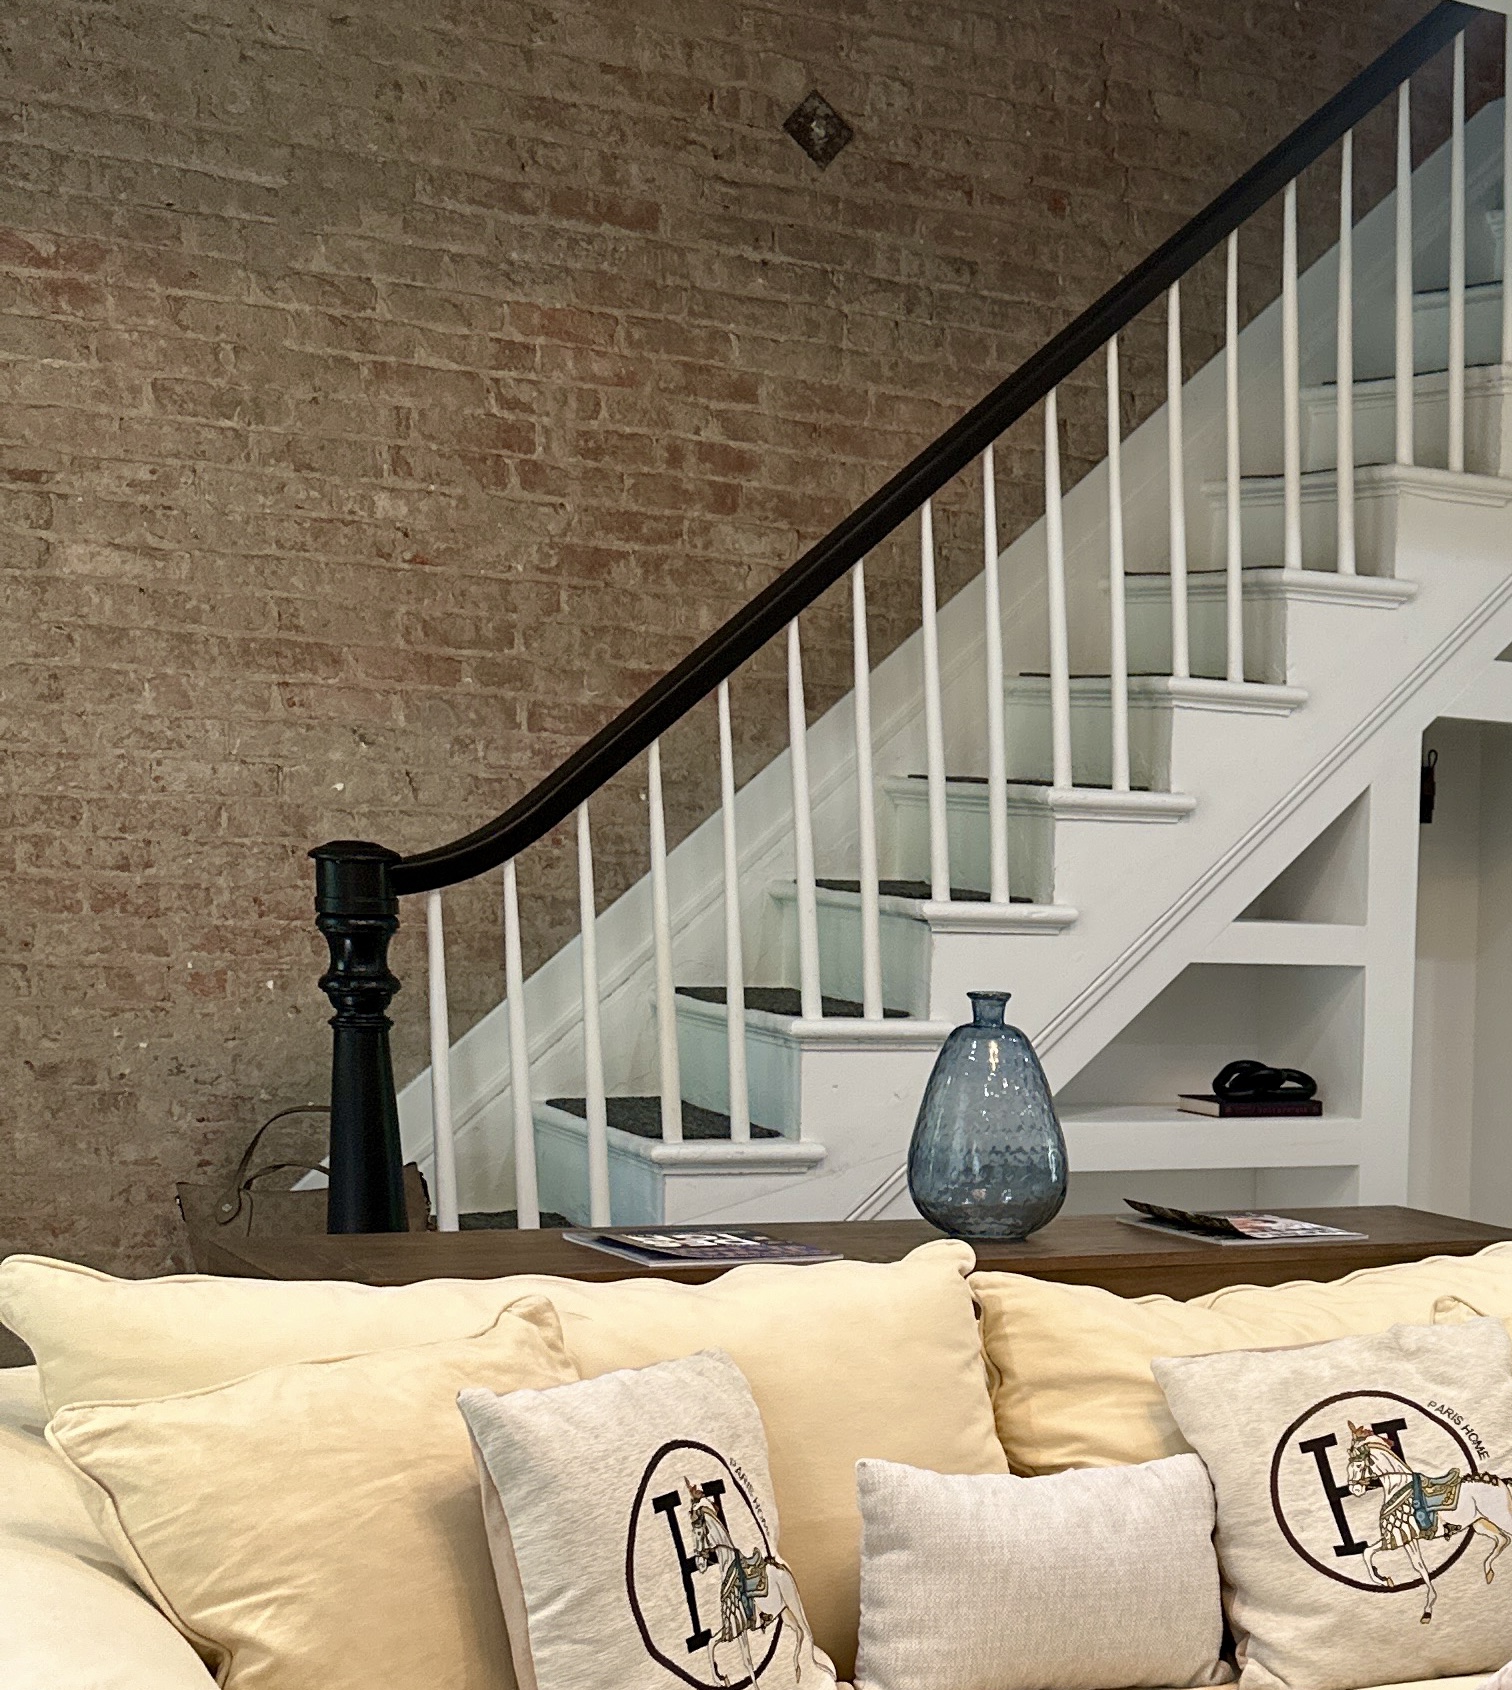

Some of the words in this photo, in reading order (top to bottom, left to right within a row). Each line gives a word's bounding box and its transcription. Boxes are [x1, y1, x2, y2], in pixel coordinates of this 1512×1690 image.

[1298, 1418, 1407, 1557] H
[1427, 1400, 1464, 1426] PARIS
[1460, 1424, 1491, 1461] HOME
[652, 1479, 726, 1653] H
